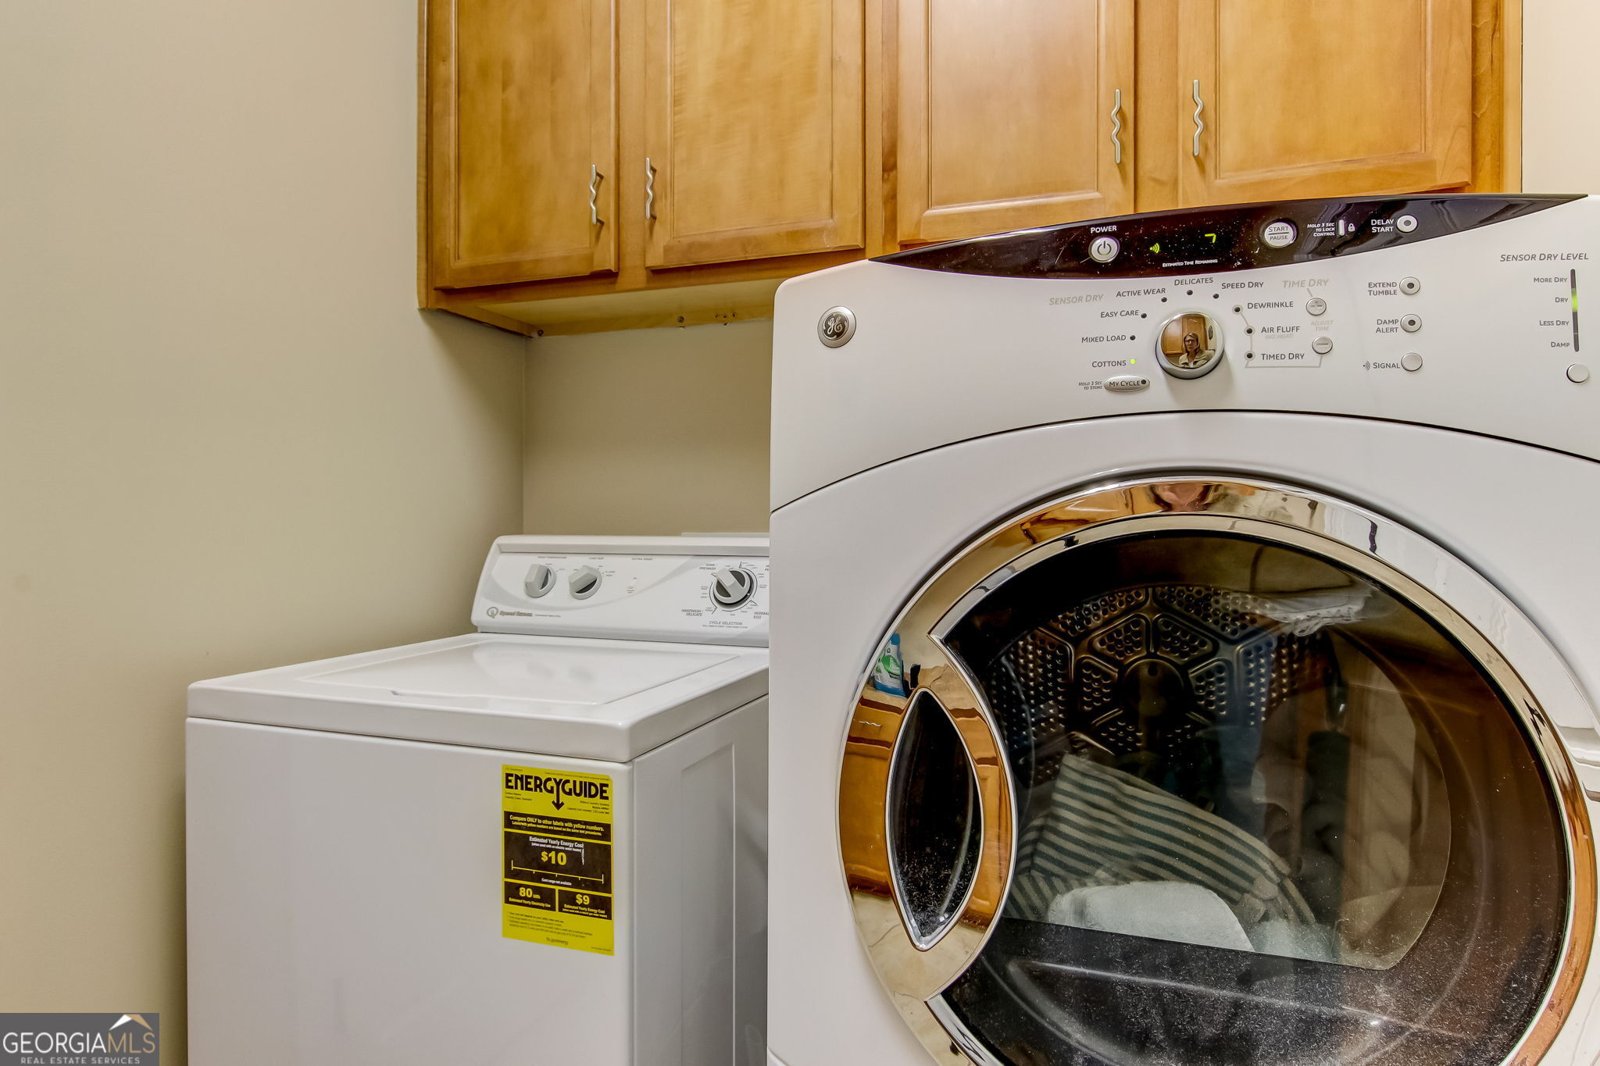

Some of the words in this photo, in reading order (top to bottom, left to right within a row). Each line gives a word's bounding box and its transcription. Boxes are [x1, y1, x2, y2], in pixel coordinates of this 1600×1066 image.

[1090, 225, 1117, 234] POWER
[1500, 254, 1537, 262] SENSOR
[1539, 253, 1559, 261] DRY
[1174, 277, 1214, 286] DELICATES
[1222, 282, 1246, 290] SPEED
[1248, 281, 1264, 289] DRY
[1282, 280, 1306, 289] TIME
[1308, 278, 1329, 288] DRY
[1085, 293, 1104, 303] DRY
[1116, 290, 1142, 298] ACTIVE
[1143, 288, 1166, 296] WEAR
[1247, 301, 1294, 309] DEWRINKLE
[1092, 360, 1127, 368] COTTONS
[505, 772, 609, 800] ENERGYGUIDE
[541, 850, 567, 865] $10
[519, 886, 533, 898] 80
[575, 893, 590, 905] $9
